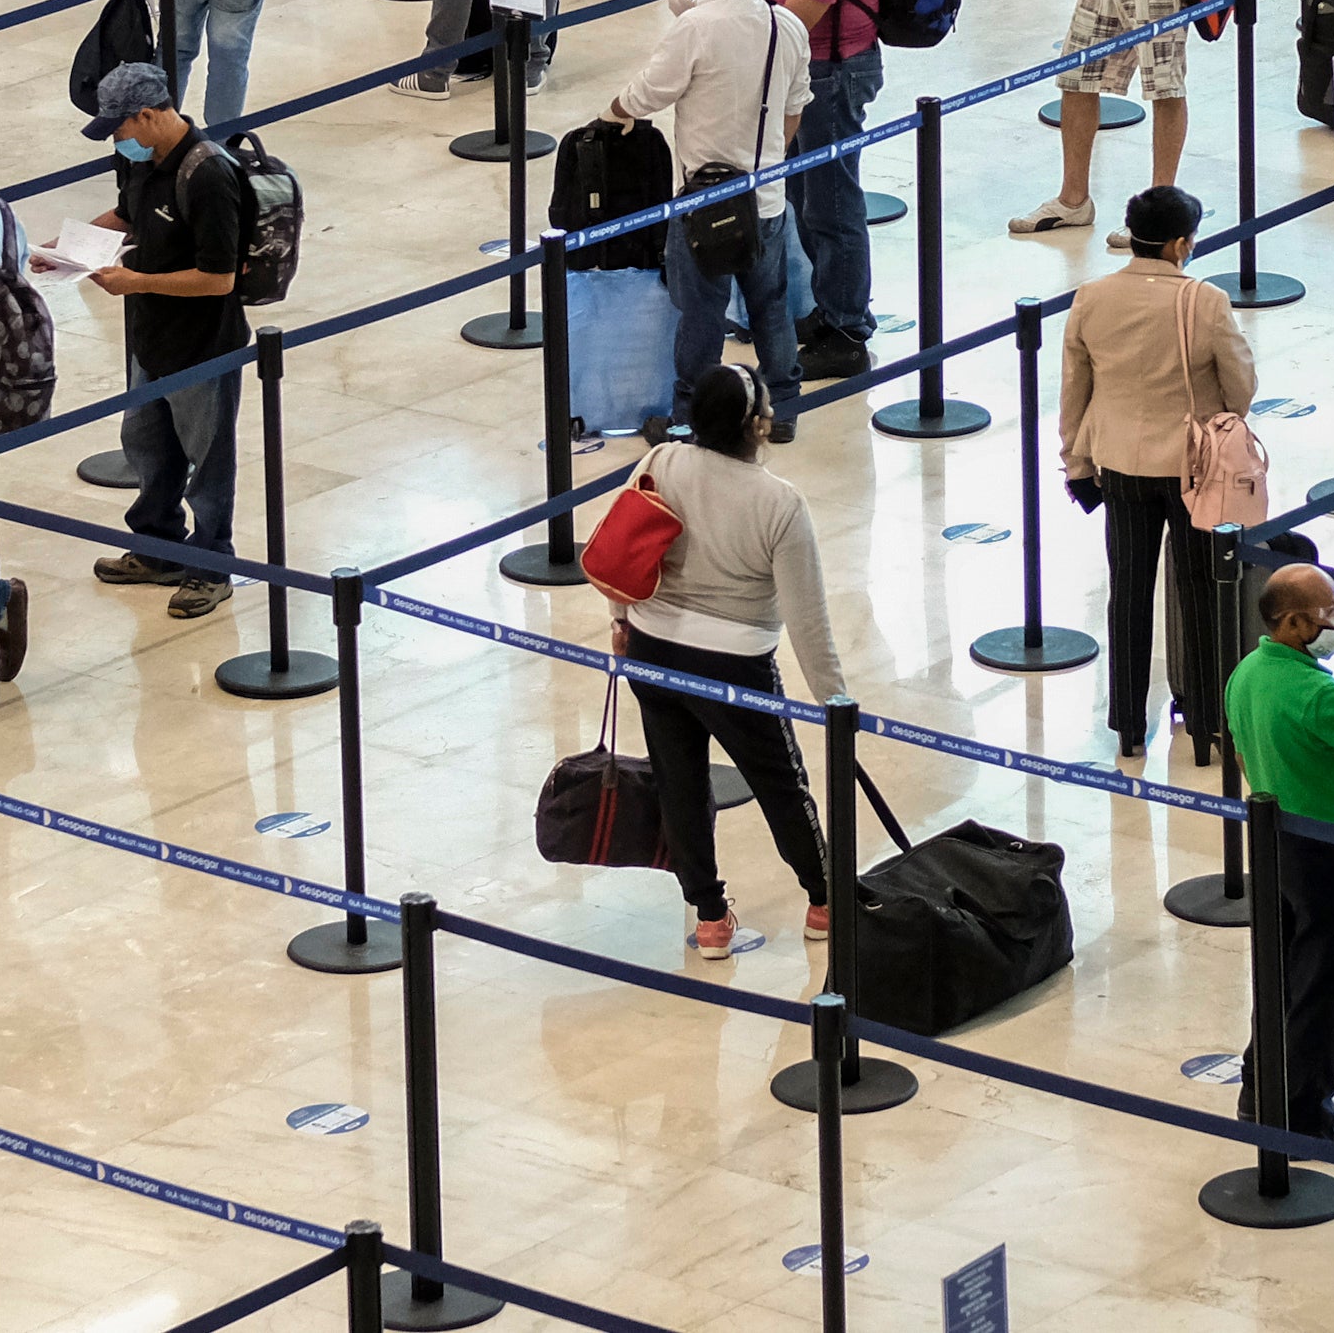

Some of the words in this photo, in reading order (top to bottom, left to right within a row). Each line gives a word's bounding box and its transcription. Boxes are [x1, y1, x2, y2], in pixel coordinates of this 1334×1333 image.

[394, 598, 435, 615] despegar
[508, 632, 549, 649] despegar
[623, 663, 664, 680] despegar
[742, 693, 784, 710] despegar
[891, 726, 936, 743] despegar
[1020, 758, 1066, 775] despegar
[1148, 787, 1195, 804] despegar
[112, 1172, 159, 1193] despegar
[243, 1211, 291, 1231] despegar
